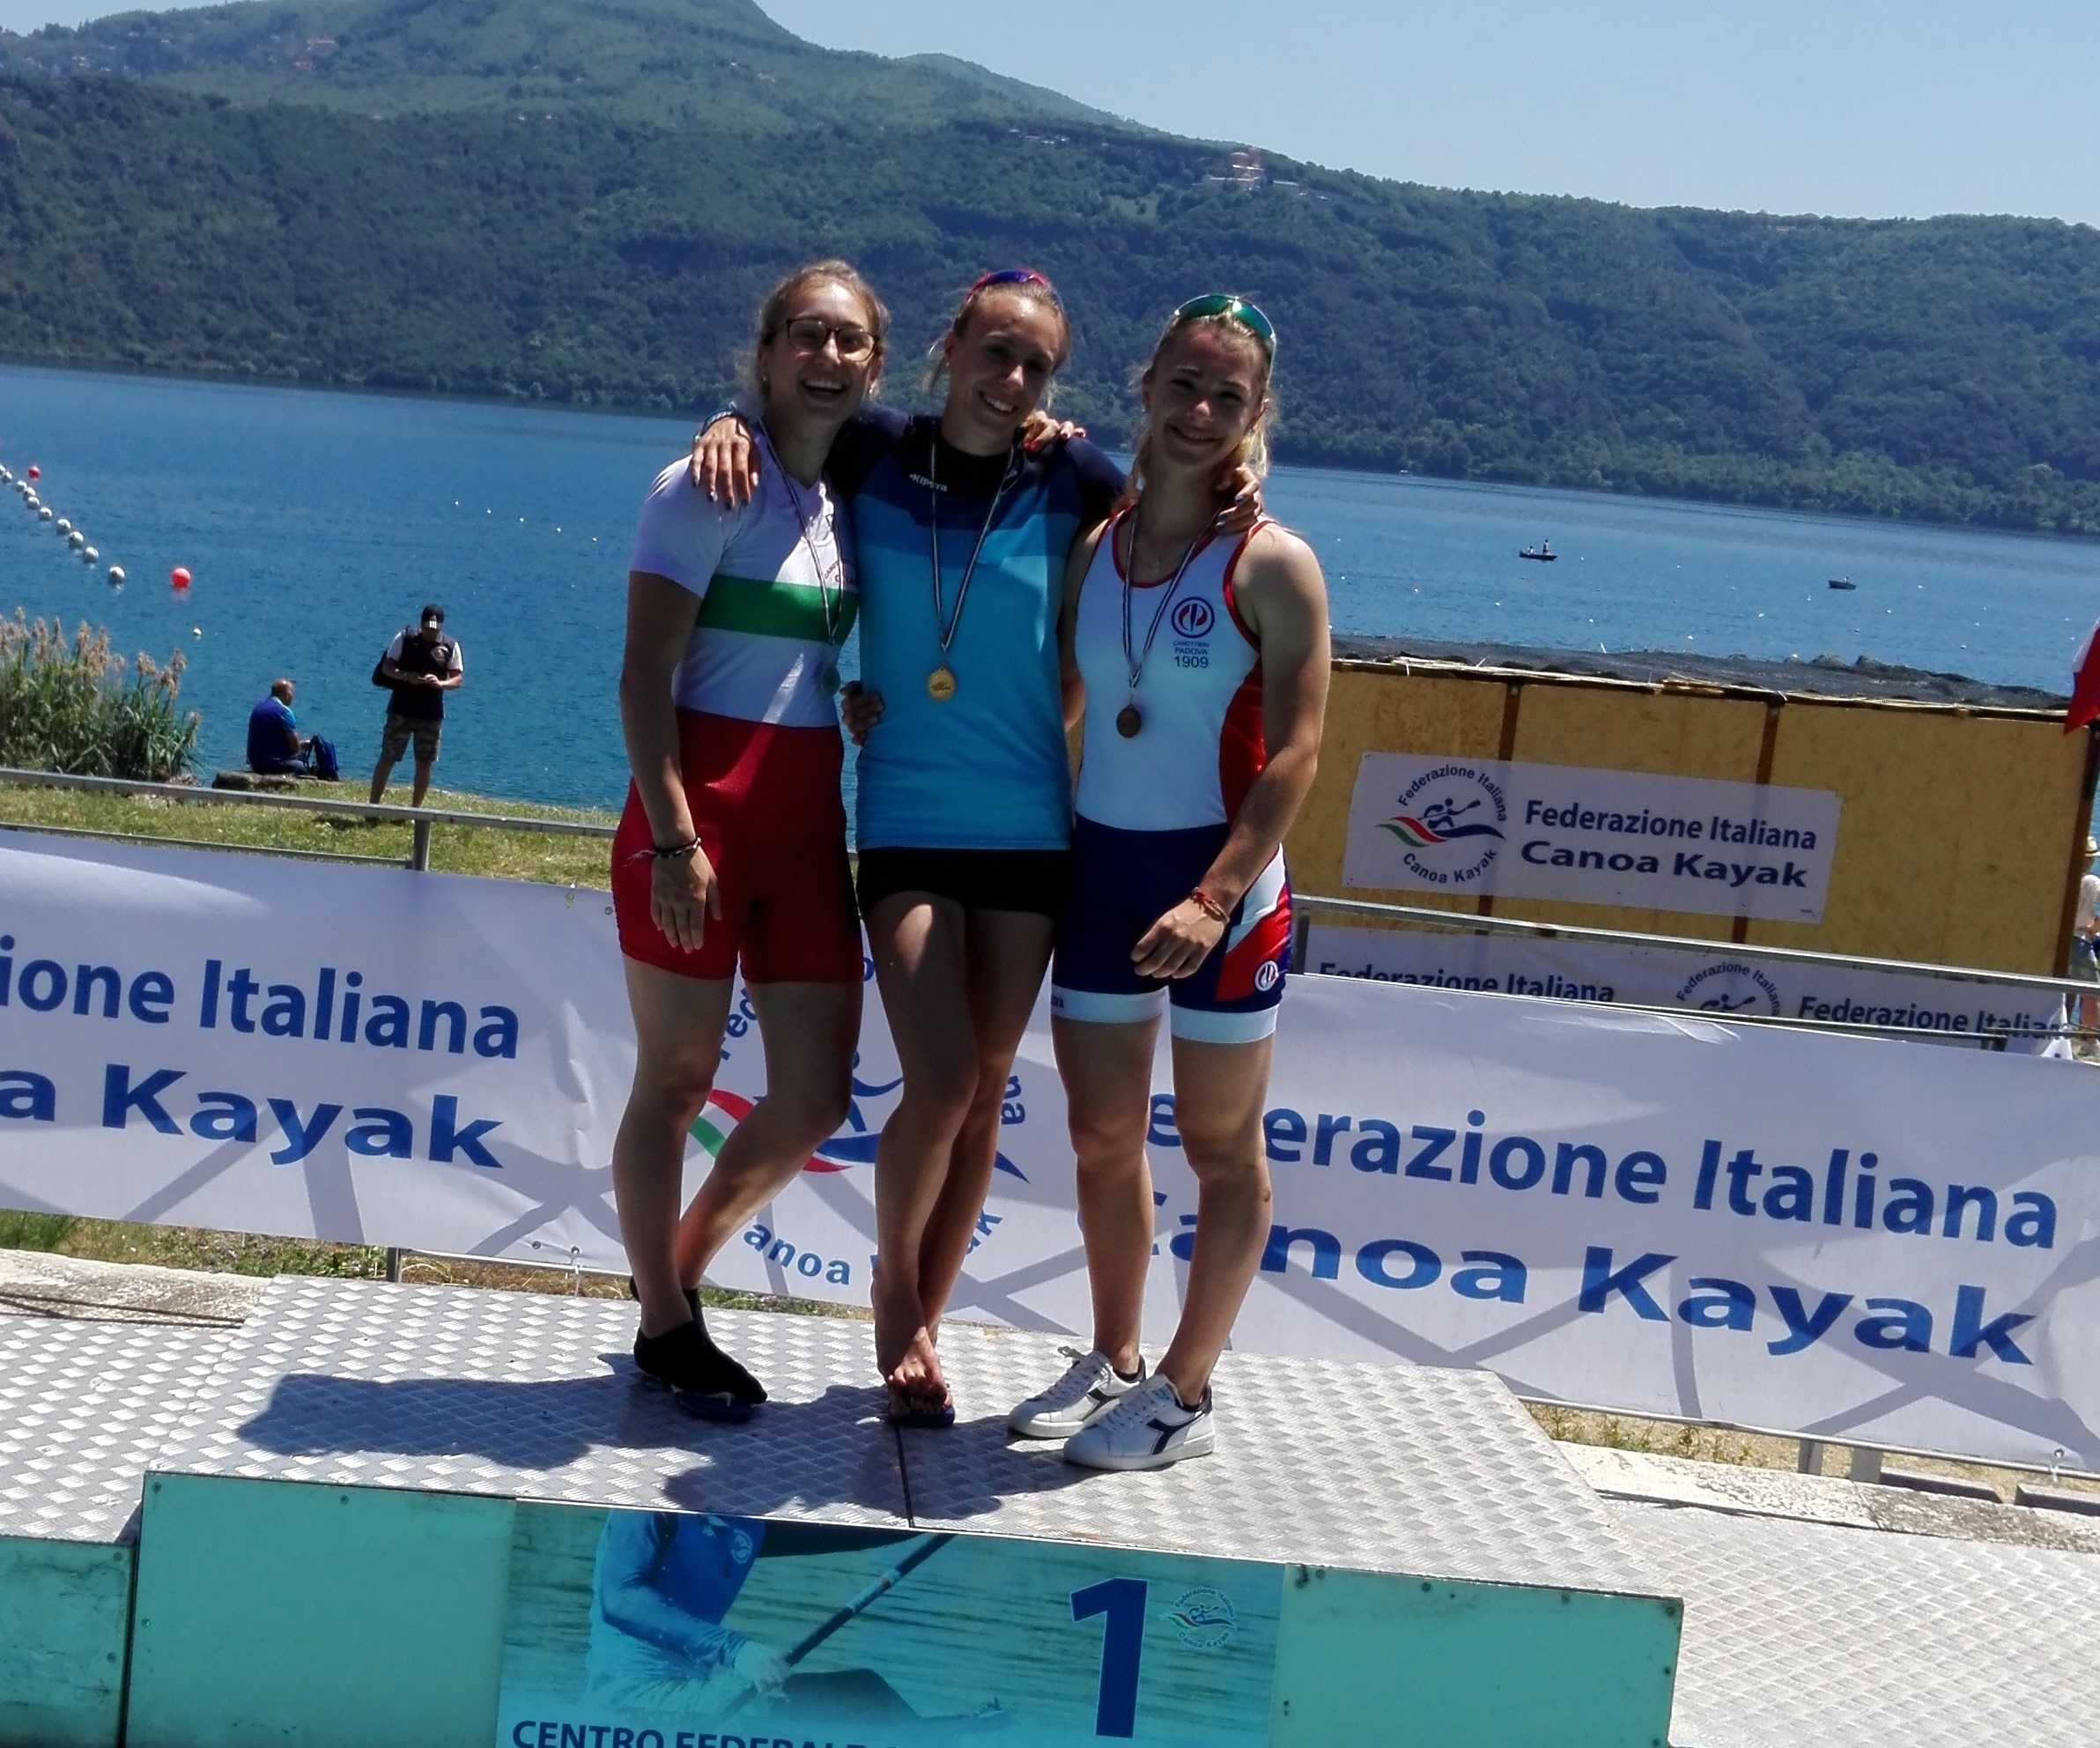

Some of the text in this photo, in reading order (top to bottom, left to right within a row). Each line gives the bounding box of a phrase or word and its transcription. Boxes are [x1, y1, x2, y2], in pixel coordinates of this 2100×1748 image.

[1174, 647, 1209, 656] PADOVA
[1174, 655, 1209, 669] 1909
[1397, 765, 1507, 822] Federazione Italiana
[1525, 799, 1817, 850] Federazione Italiana
[1402, 848, 1497, 884] Canoa Kayak
[1520, 841, 1808, 888] Canoa Kayak
[1319, 962, 1615, 1003] Fdrazione Italiana
[1675, 961, 1780, 1017] Federazione Italiana
[199, 959, 520, 1060] Italiana
[1798, 996, 1969, 1032] Federazione
[101, 1063, 504, 1169] Kayak
[1146, 1092, 1667, 1204] eerazione
[1693, 1139, 2057, 1249] Italiana
[743, 1222, 851, 1285] anoa
[1578, 1245, 2037, 1366] Kayak
[1069, 1576, 1150, 1738] 1
[512, 1720, 665, 1748] CENTRO
